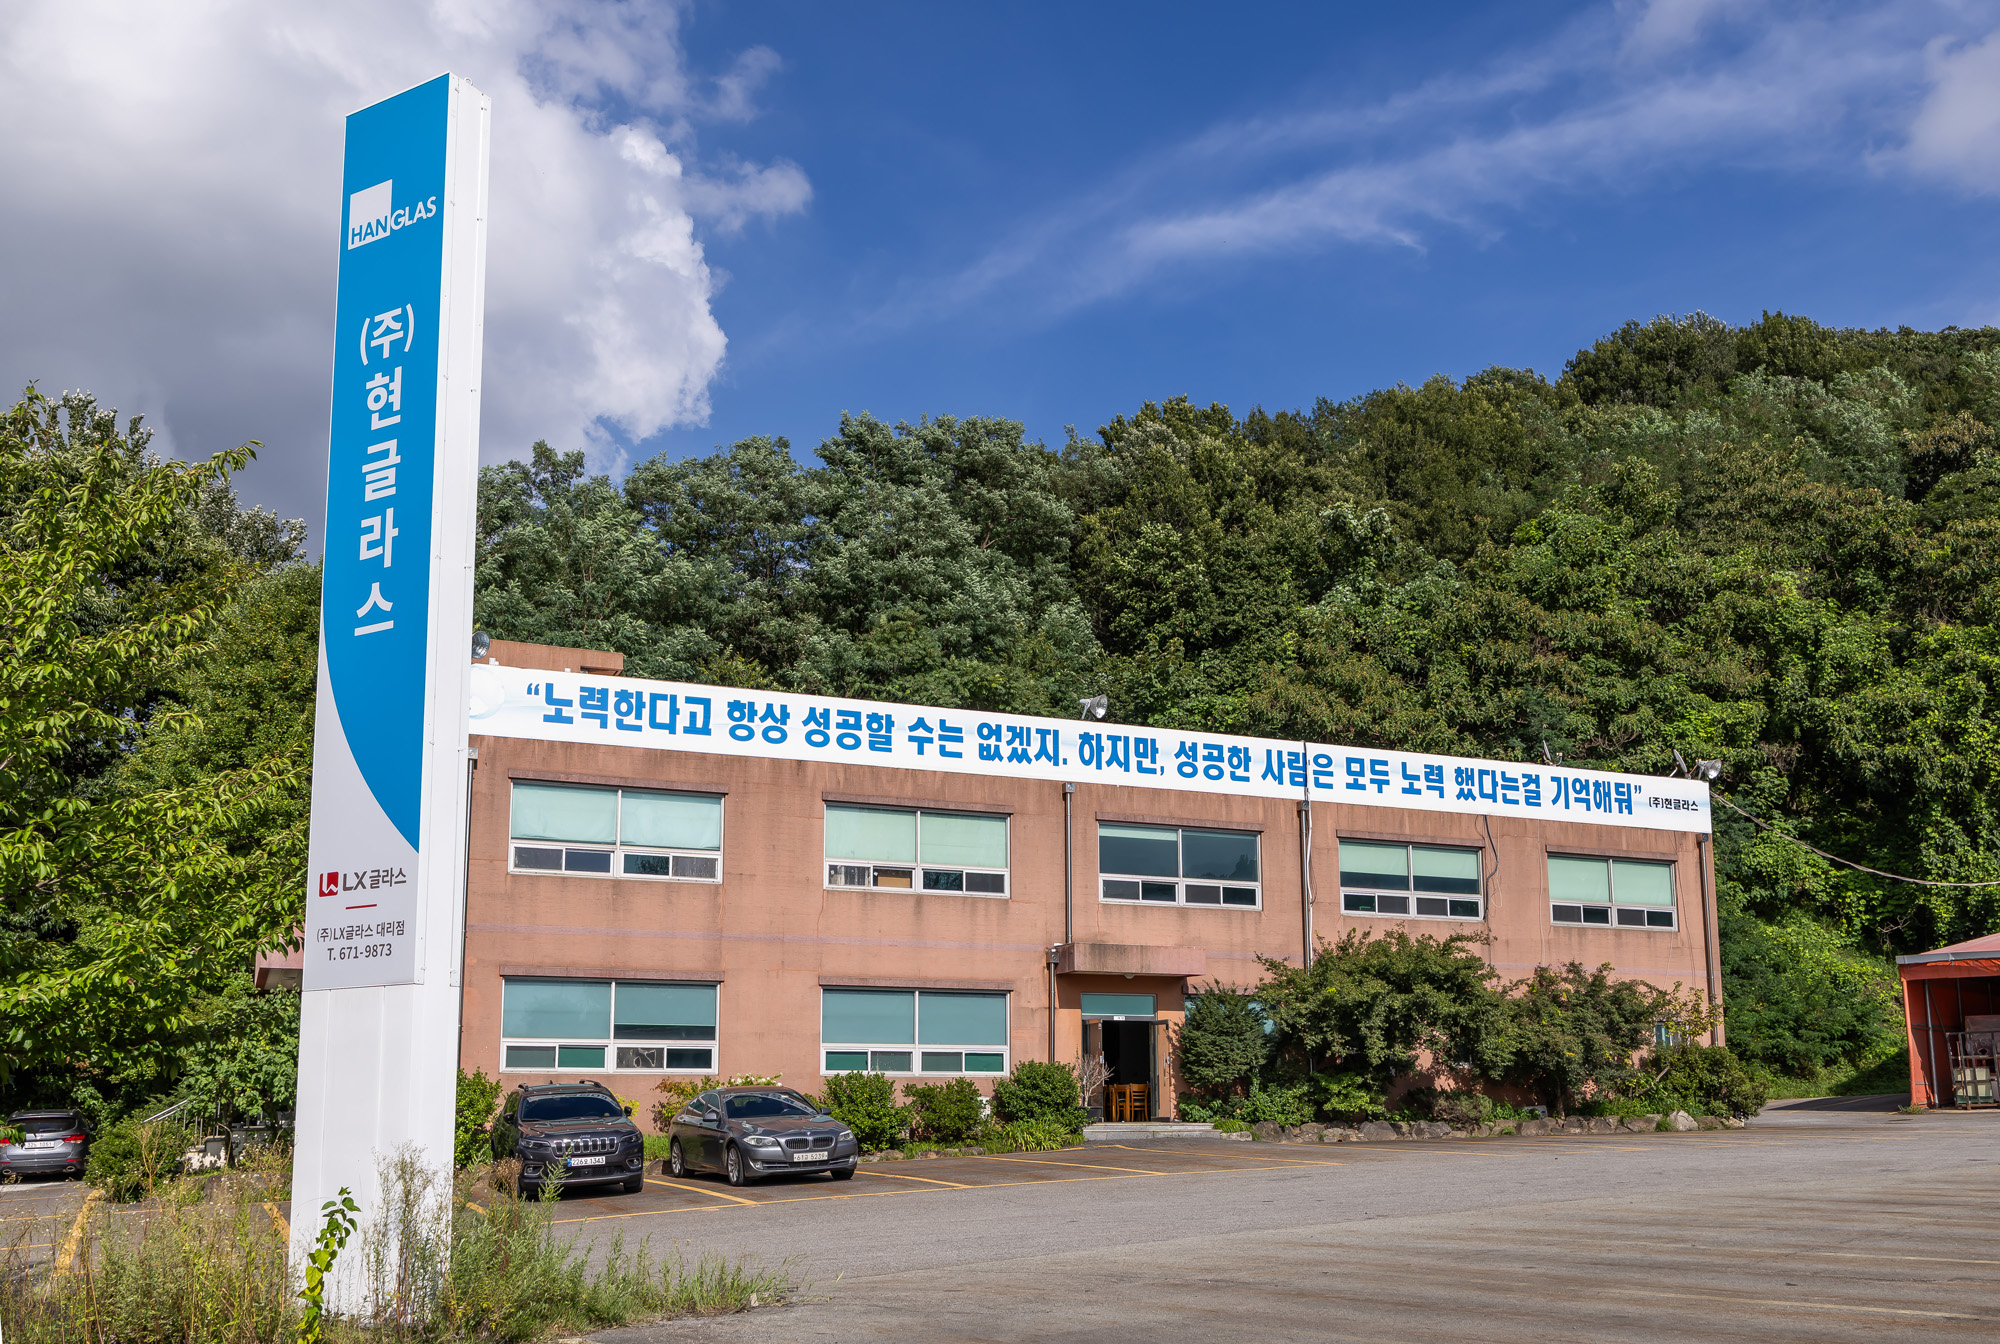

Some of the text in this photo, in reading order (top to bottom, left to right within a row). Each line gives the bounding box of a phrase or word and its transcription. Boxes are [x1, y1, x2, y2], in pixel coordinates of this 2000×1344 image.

[351, 196, 437, 246] HANGLAS
[526, 682, 1642, 815] “노력한다고 항상 성공할 수는 없겠지. 하지만, 성공한 사람은 모두 노력 했다는걸 기억해둬”
[1648, 796, 1699, 811] (주)현글라스
[342, 867, 407, 892] LX글라스
[316, 919, 405, 943] (주)LX글라스 대리점
[327, 942, 393, 961] T. 671-9873
